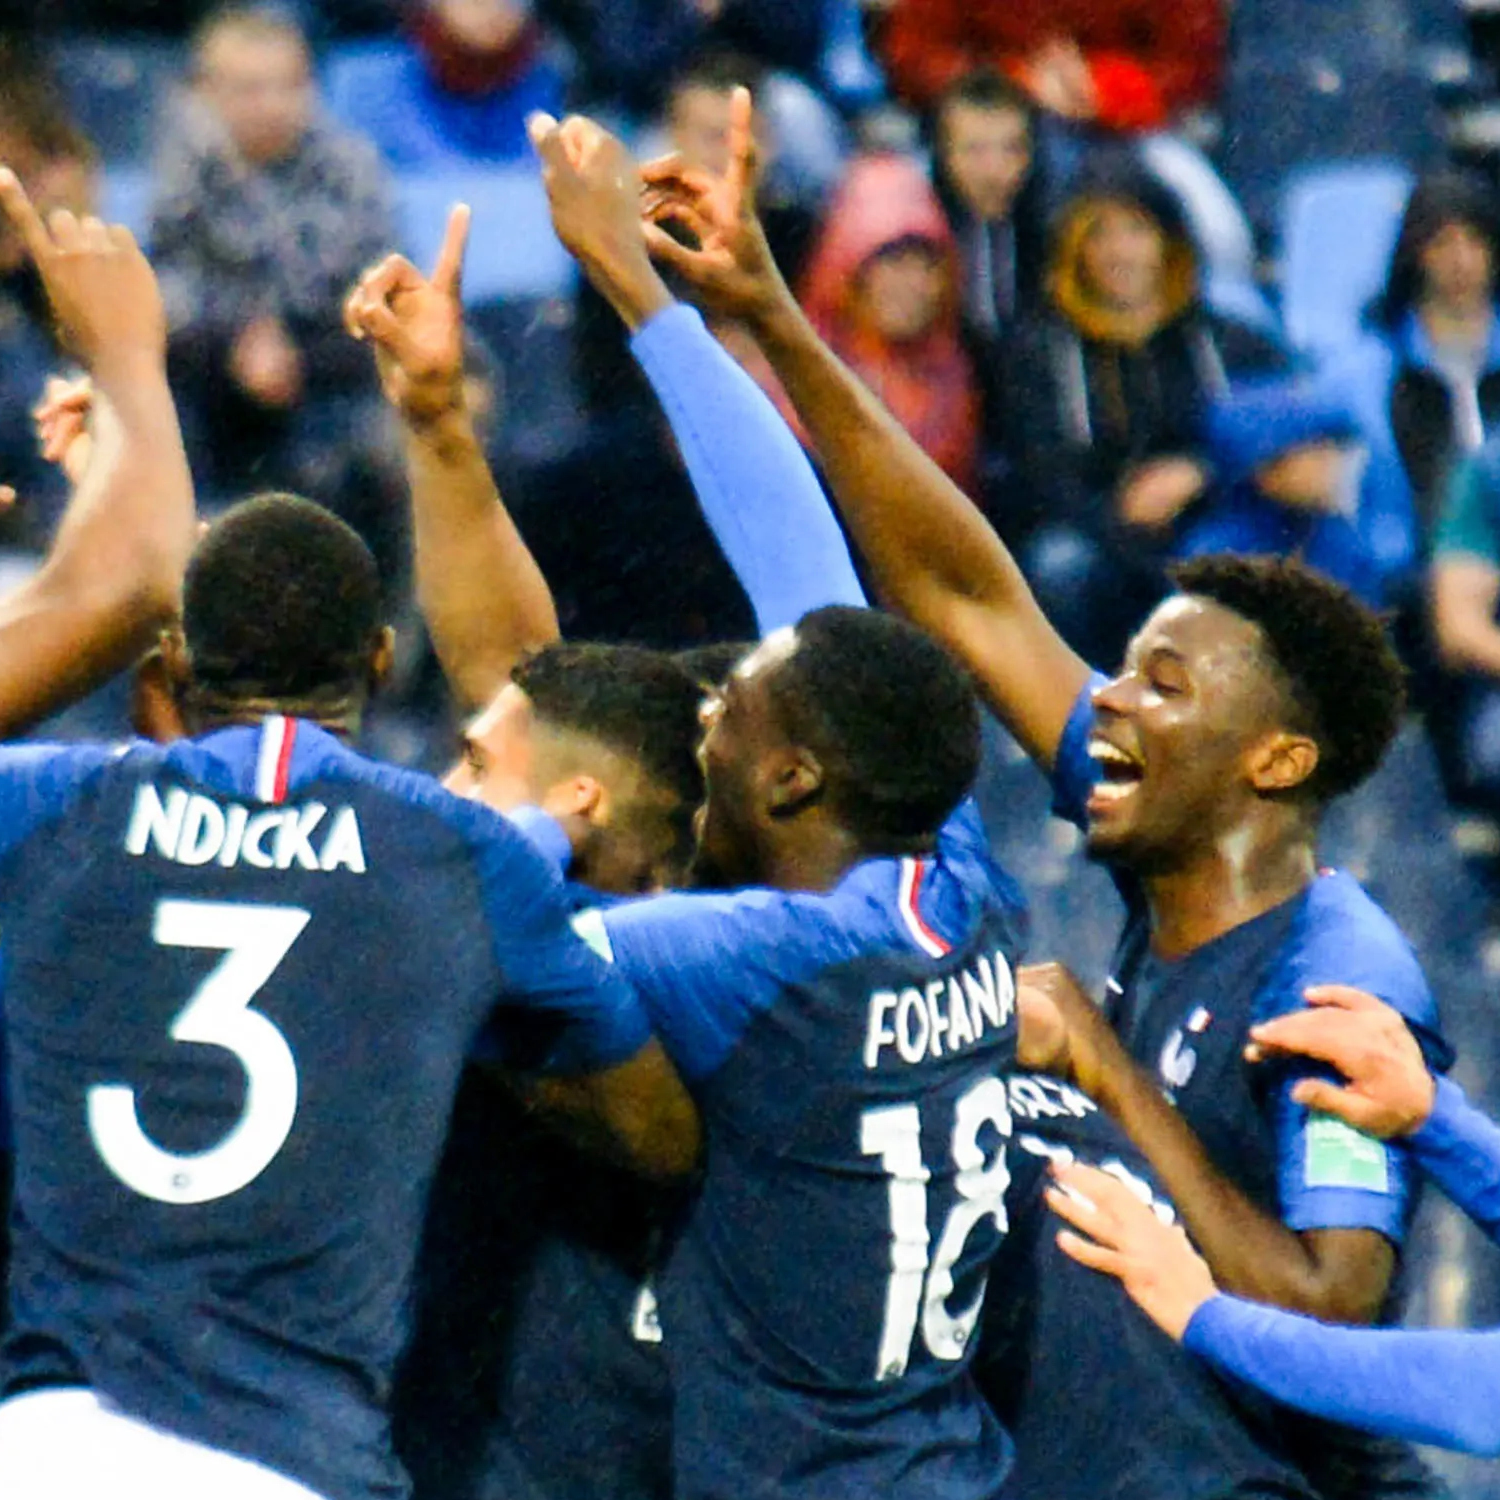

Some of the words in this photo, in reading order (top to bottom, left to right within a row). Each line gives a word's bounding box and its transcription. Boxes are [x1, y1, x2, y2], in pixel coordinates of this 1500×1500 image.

[125, 783, 367, 874] NDICKA
[88, 899, 313, 1205] 3
[864, 950, 1017, 1068] FOFANA
